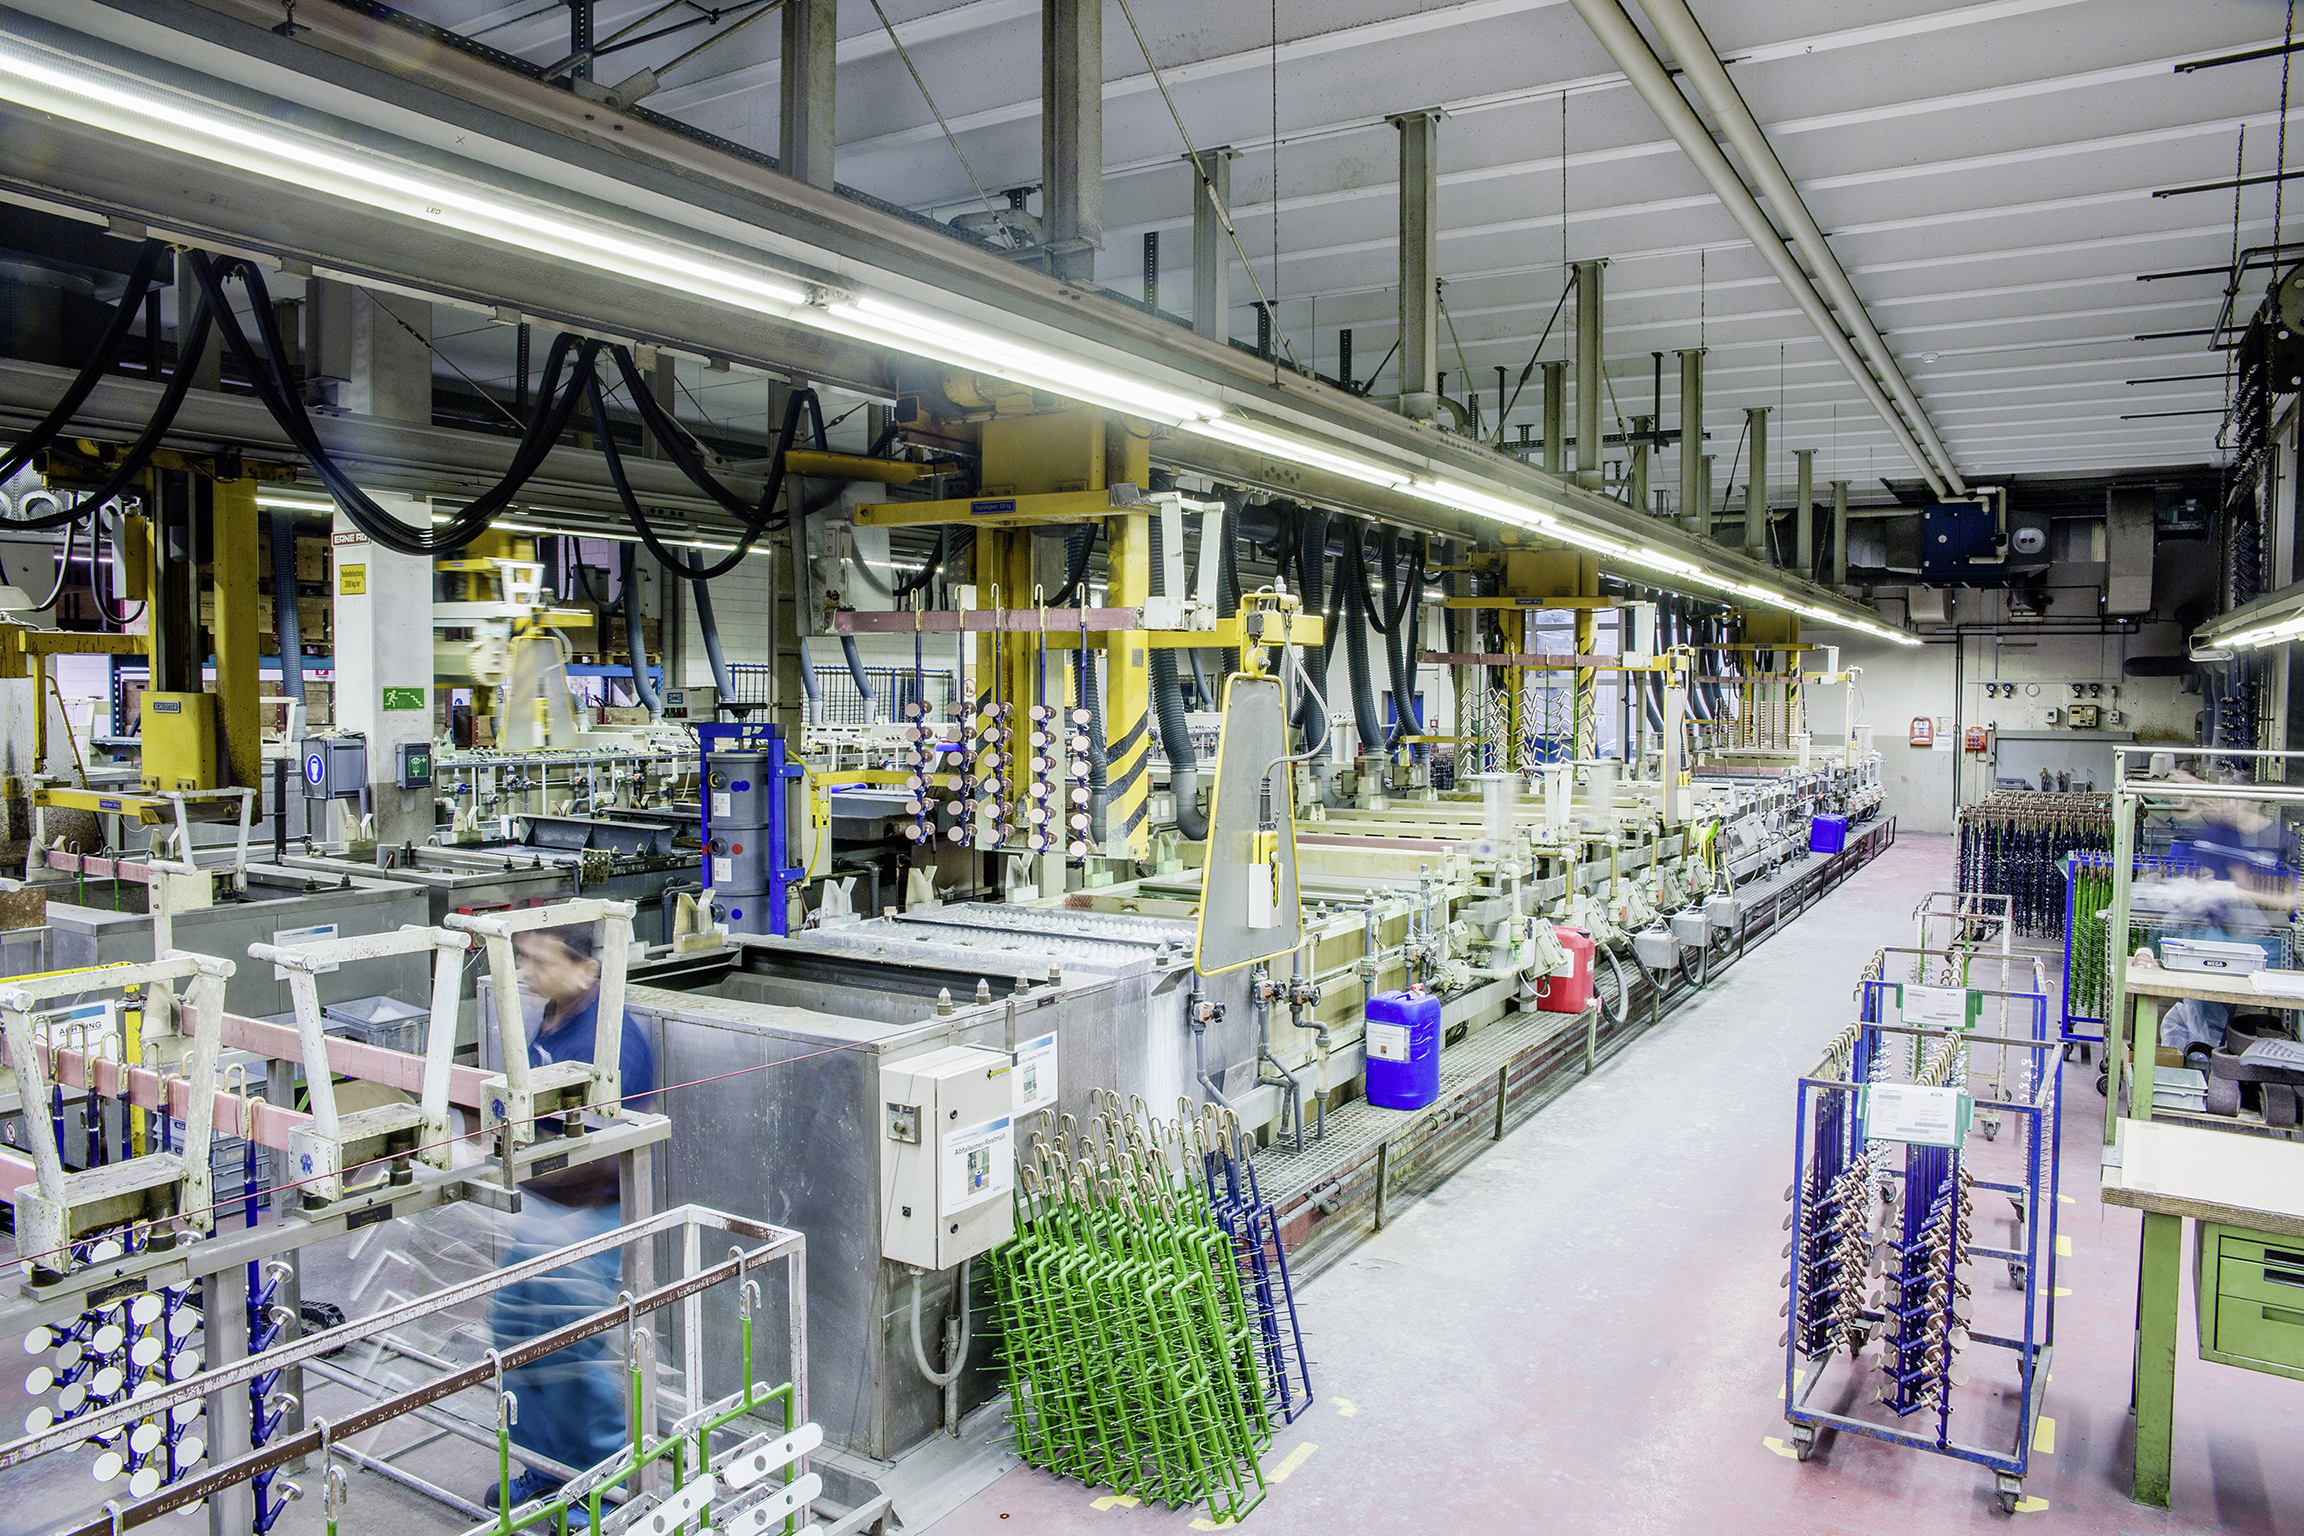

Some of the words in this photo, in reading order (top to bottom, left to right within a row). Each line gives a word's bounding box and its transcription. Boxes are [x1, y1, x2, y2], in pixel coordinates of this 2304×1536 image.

[425, 206, 442, 215] LED
[334, 533, 355, 544] ERNE
[356, 531, 368, 542] AG
[542, 910, 549, 922] 3
[59, 1021, 102, 1035] AHNG
[954, 1132, 1006, 1156] Abfalleimer-Restmüll
